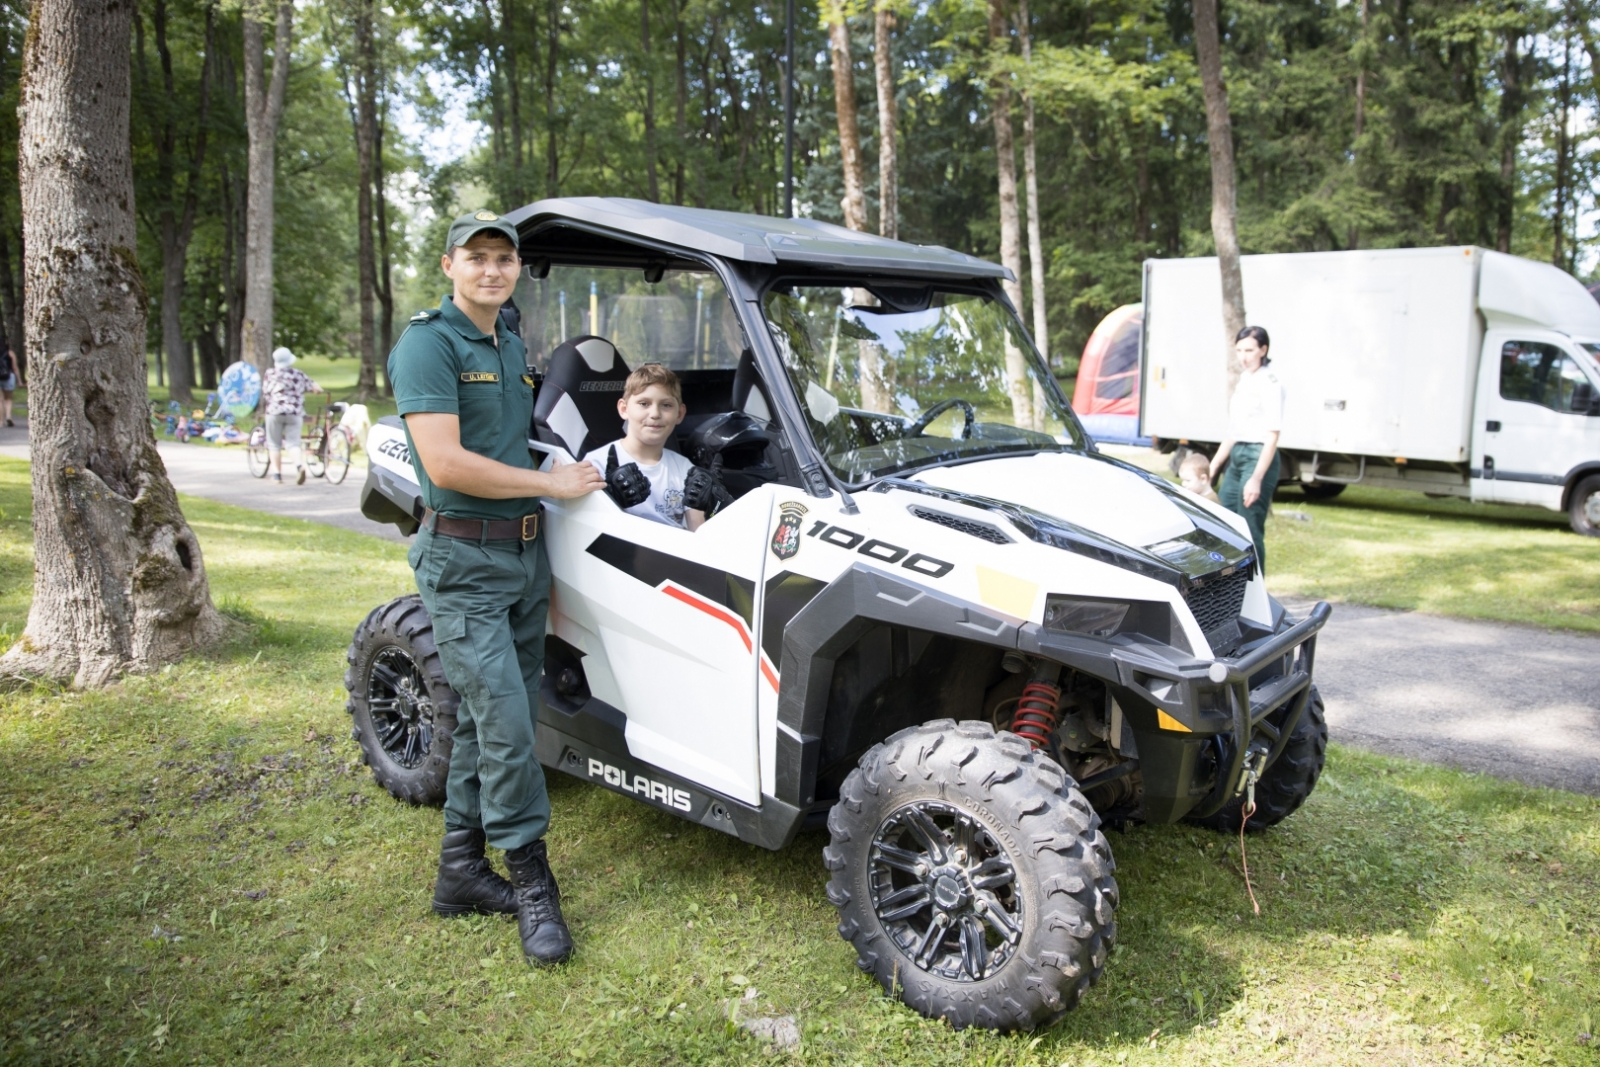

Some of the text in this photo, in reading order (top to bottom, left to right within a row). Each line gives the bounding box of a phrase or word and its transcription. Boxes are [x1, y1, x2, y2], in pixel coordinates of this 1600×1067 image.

[806, 520, 955, 578] 1000
[588, 758, 692, 812] POLARIS
[964, 796, 1021, 858] CORONADO
[916, 978, 1009, 1003] MAXXIS
